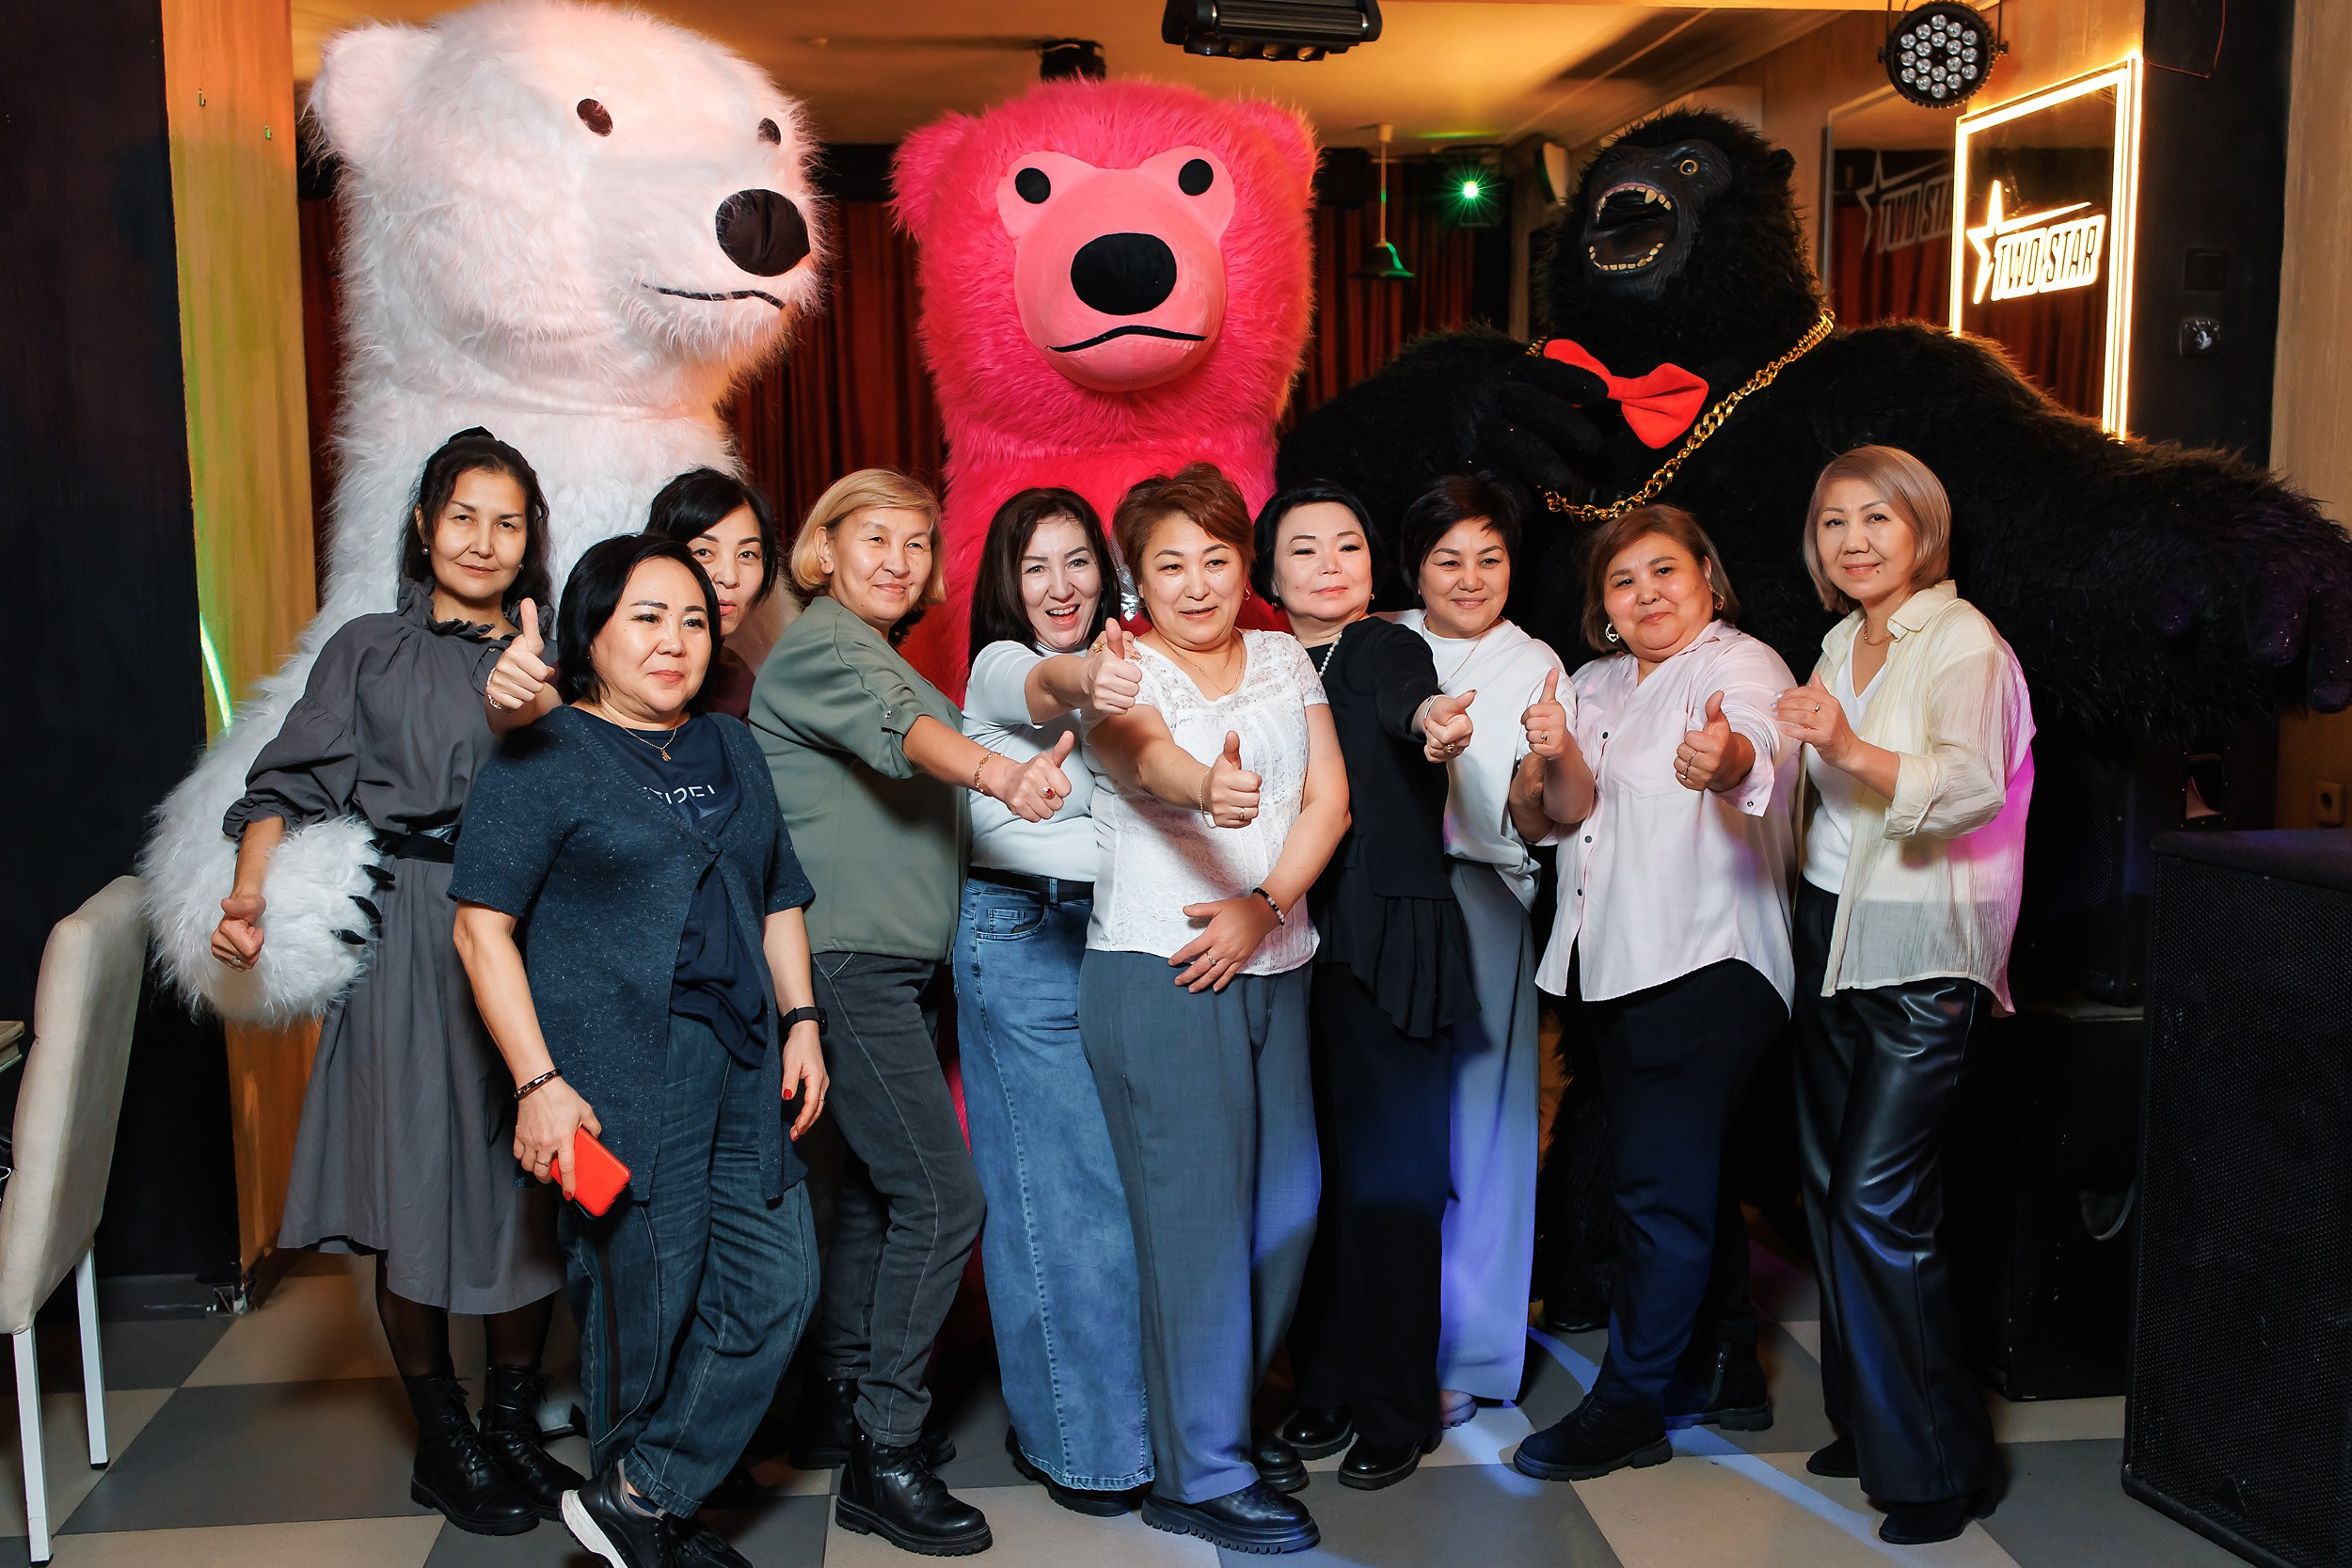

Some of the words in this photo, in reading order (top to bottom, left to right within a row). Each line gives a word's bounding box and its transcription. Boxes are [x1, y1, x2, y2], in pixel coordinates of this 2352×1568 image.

[1879, 185, 1921, 251] TWO
[1993, 231, 2044, 297] TWO
[2042, 217, 2103, 291] STAR
